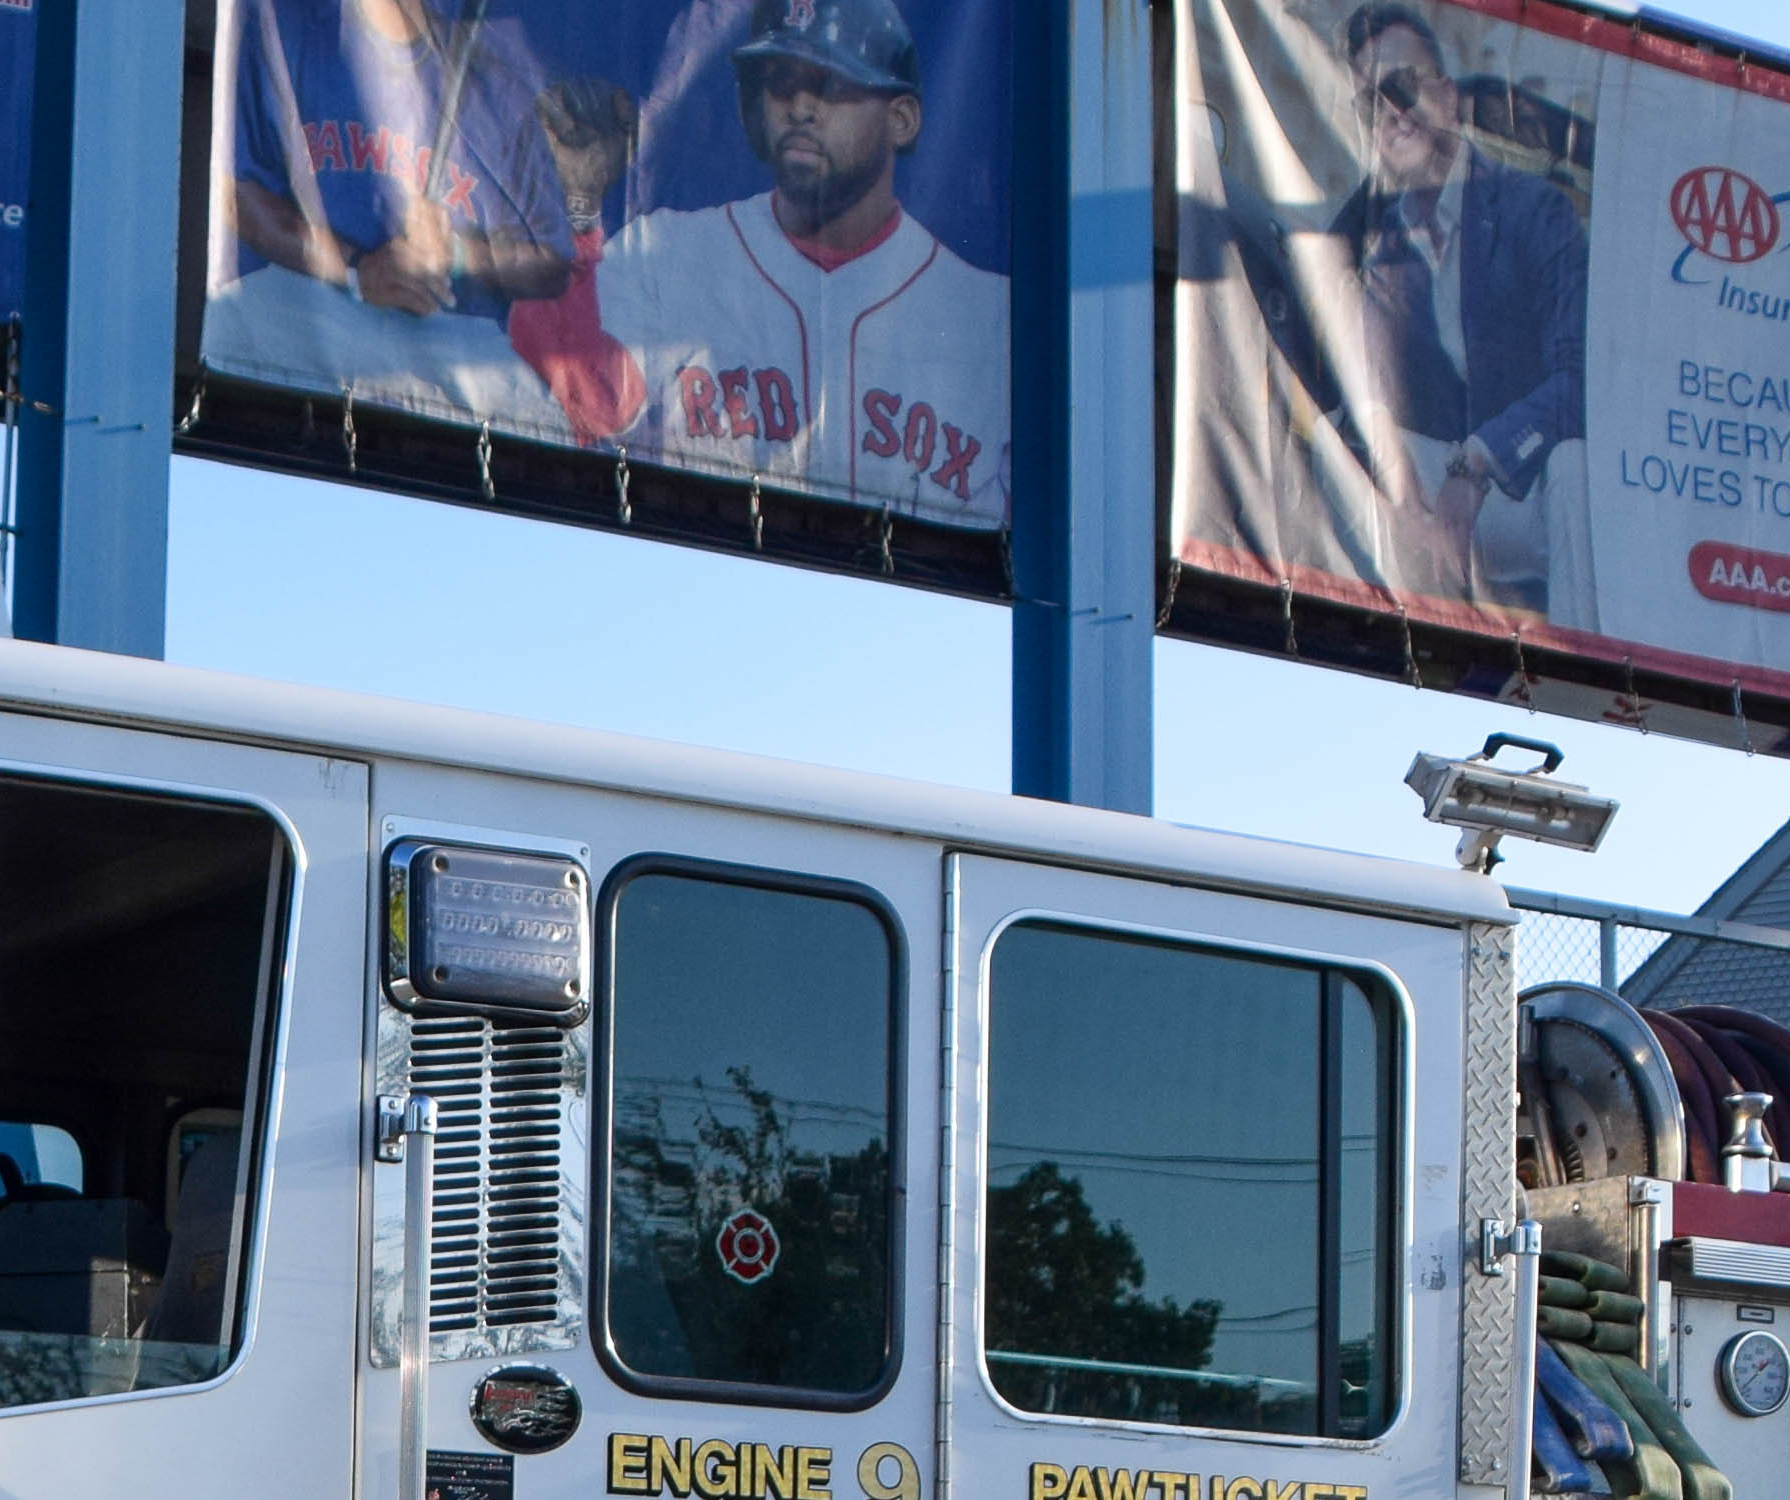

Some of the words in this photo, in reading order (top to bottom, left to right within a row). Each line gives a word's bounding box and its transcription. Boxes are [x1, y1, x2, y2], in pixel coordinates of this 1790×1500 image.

[1672, 167, 1777, 262] AAA
[675, 365, 801, 442] RED
[862, 387, 981, 501] SOX
[1620, 450, 1743, 507] LOVES
